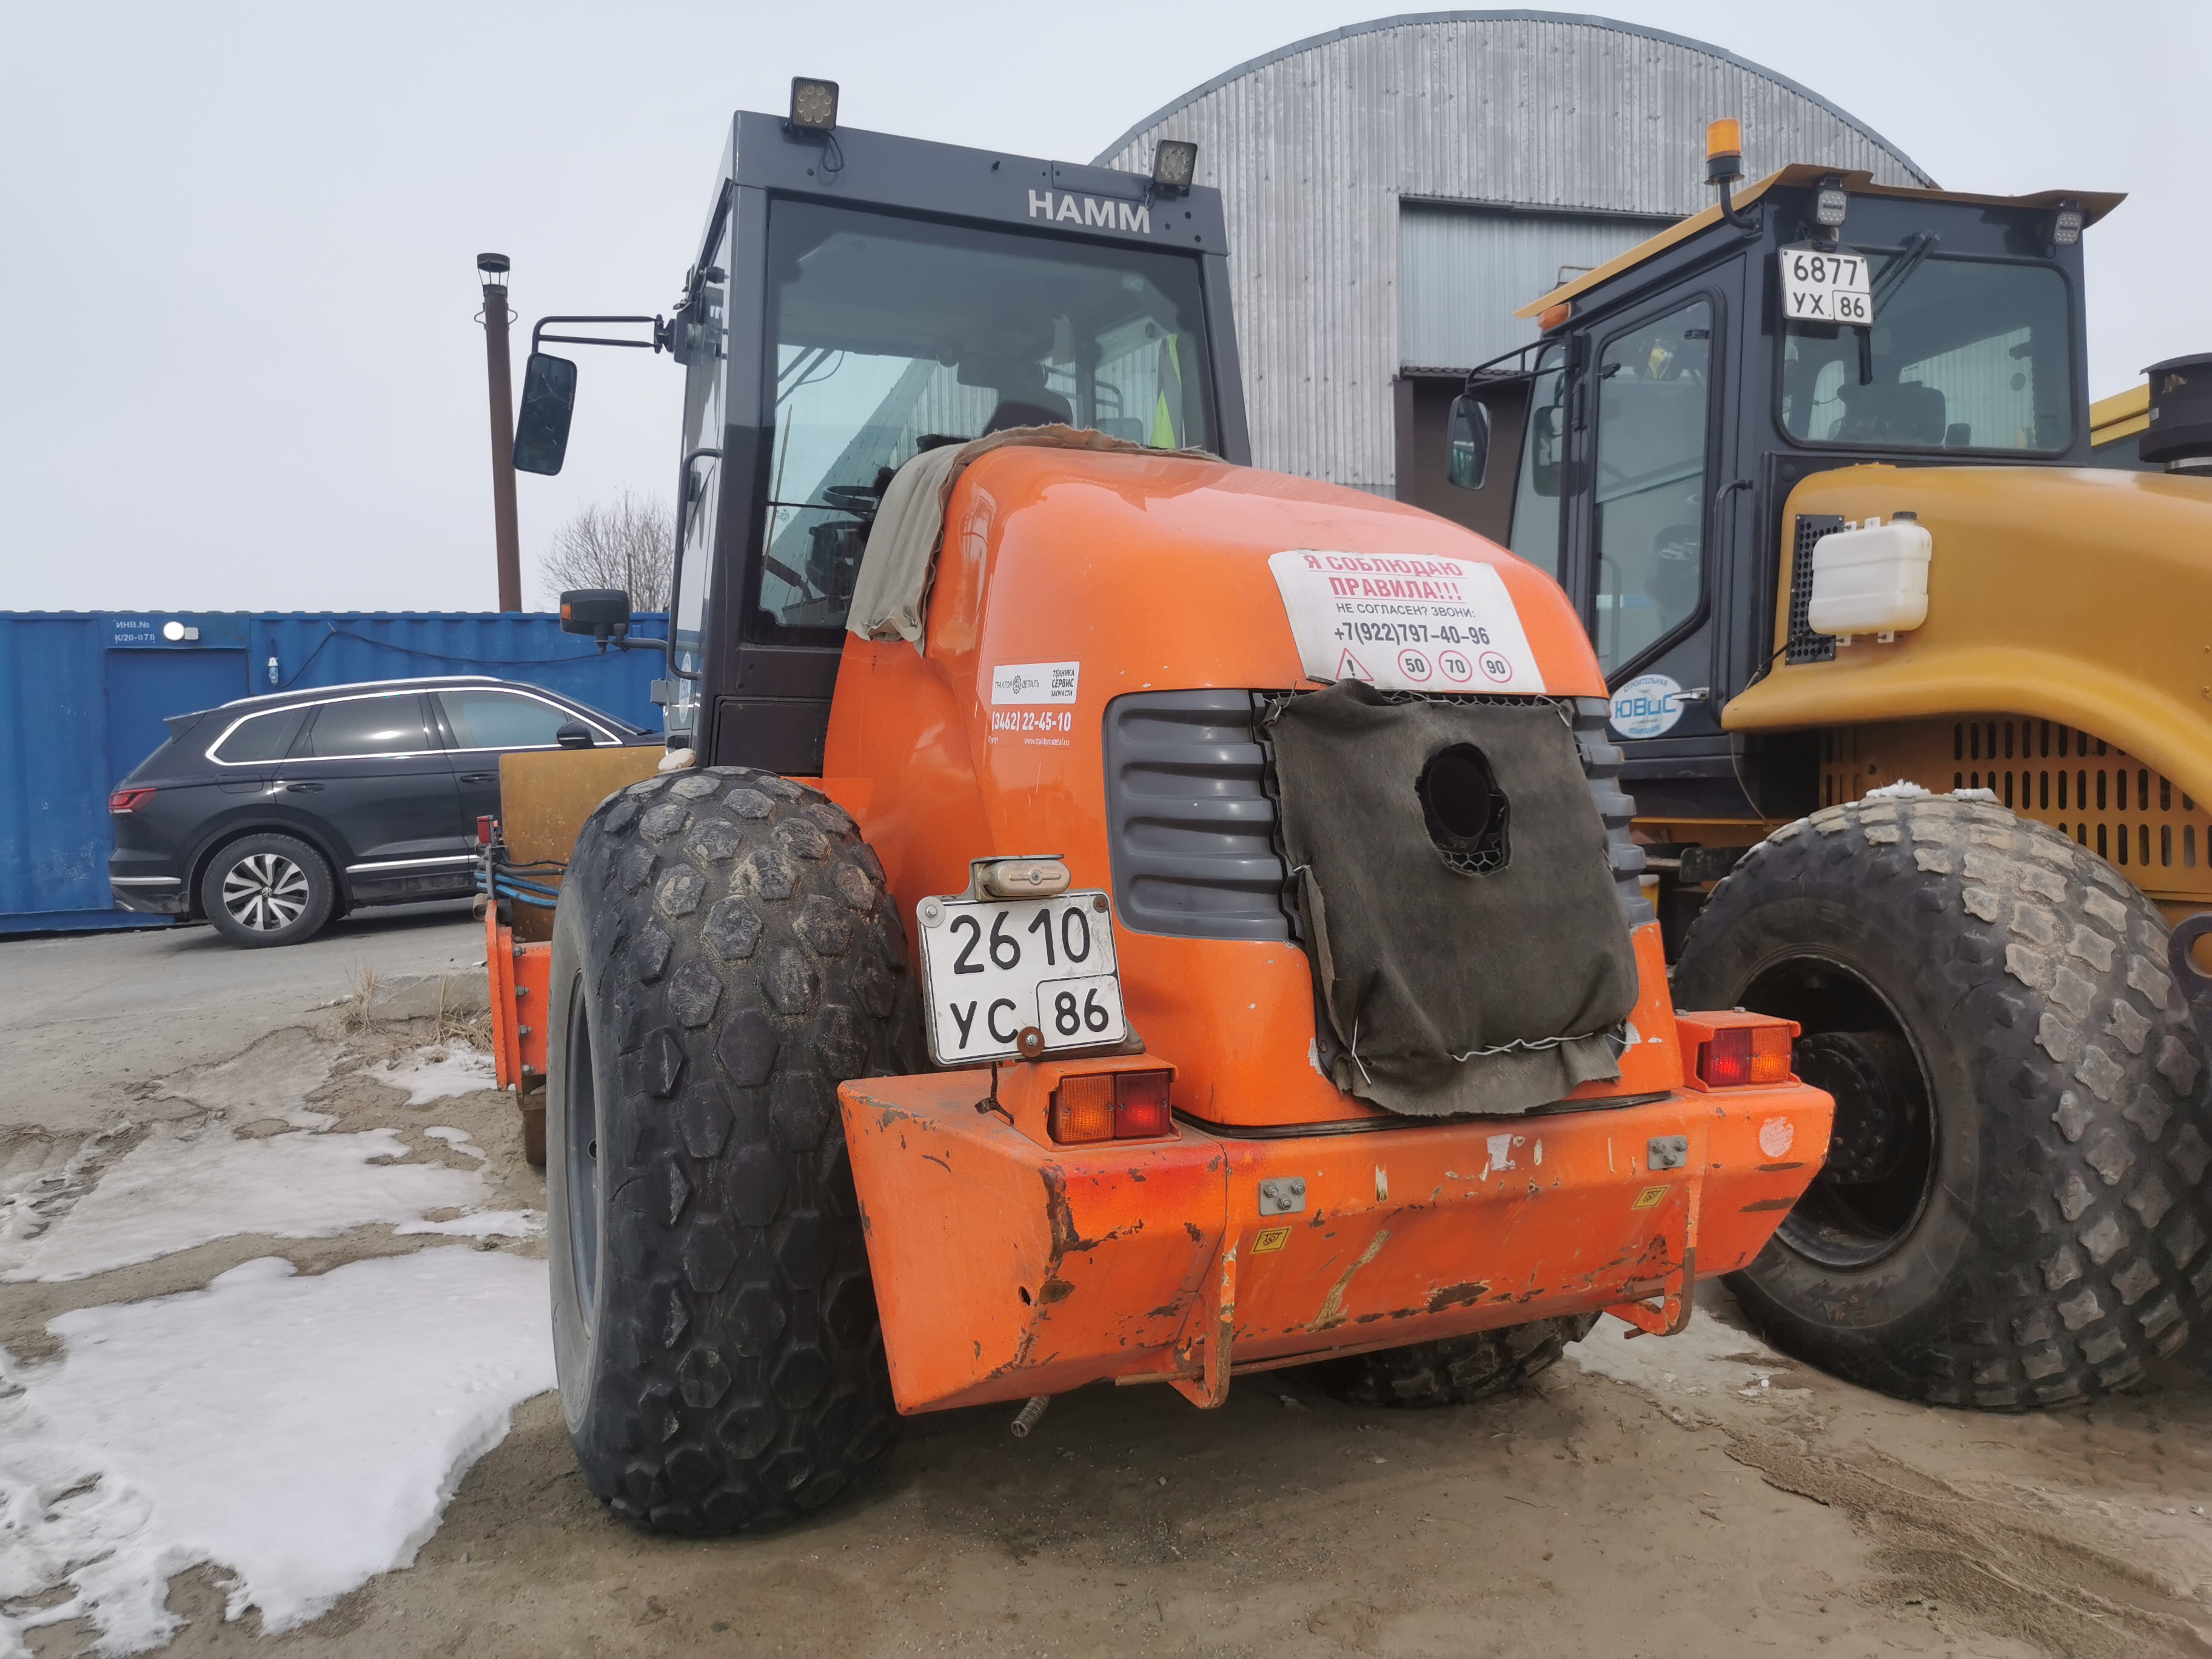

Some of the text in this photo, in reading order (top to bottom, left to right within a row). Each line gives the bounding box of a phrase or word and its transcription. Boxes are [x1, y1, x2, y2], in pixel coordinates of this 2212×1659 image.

[1028, 189, 1150, 234] HAMM
[1794, 255, 1857, 286] 6877
[1792, 292, 1865, 318] УХ 86
[1303, 555, 1464, 577] Я СОБЛЮДАЮ
[1329, 577, 1462, 600] ПРАВИЛА!!!
[1336, 603, 1476, 618] НЕ СОГЛАСЕН? ЗВОНИ:
[1335, 622, 1490, 646] +7(922)797-40-96
[1053, 669, 1074, 677] ТЕХНИКА
[1406, 658, 1426, 673] 50
[1446, 659, 1466, 674] 70
[1486, 660, 1506, 675] 90
[994, 680, 1039, 689] ТРАКТОР ДЕТАЛЬ
[1051, 678, 1074, 688] СЕРВИС
[991, 711, 1071, 732] (3462) 22-45-10
[950, 907, 1091, 974] 2610
[950, 988, 1109, 1050] УС 86
